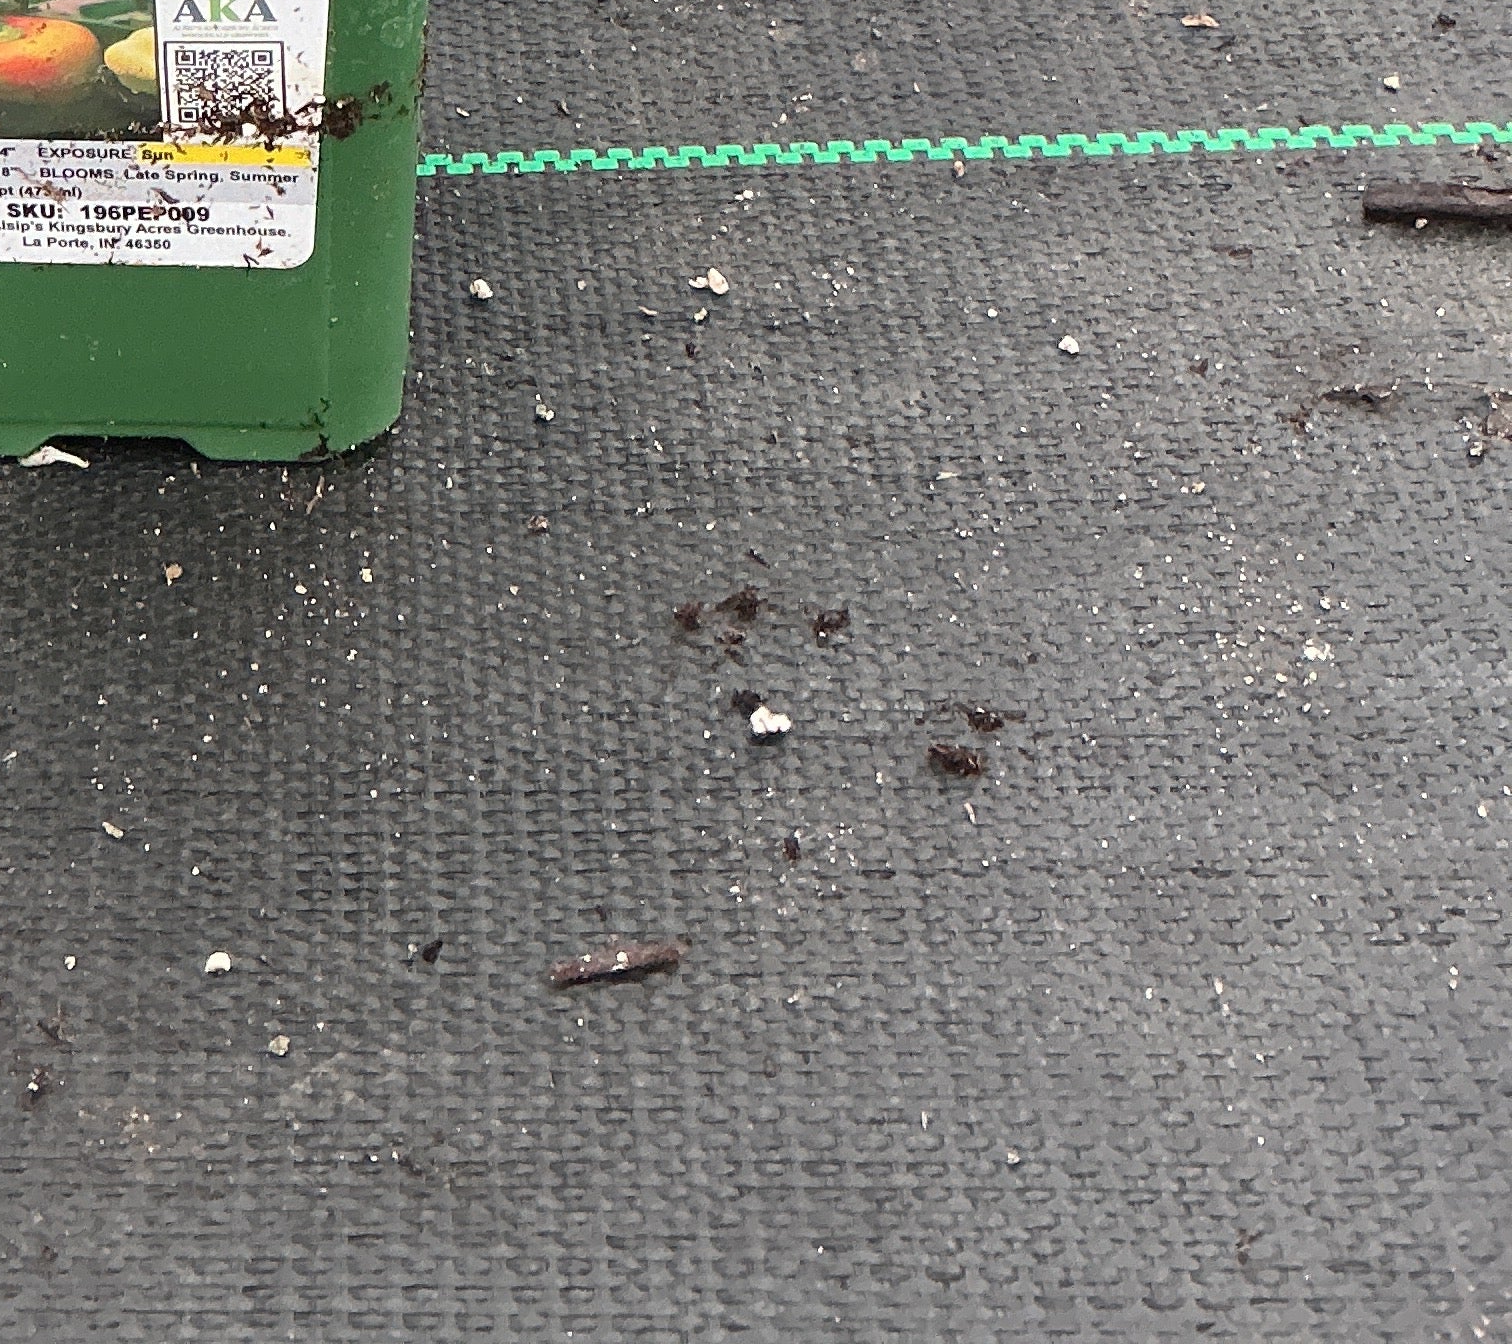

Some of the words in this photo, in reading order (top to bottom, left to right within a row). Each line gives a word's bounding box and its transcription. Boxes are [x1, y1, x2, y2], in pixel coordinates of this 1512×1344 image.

[141, 149, 174, 161] Sun
[124, 169, 160, 181] Late
[164, 170, 224, 184] Spring,
[229, 171, 299, 184] Summer
[7, 202, 64, 220] SKU:
[49, 220, 132, 235] Kingsbury
[135, 223, 182, 235] Acres
[22, 236, 42, 247] La
[125, 238, 172, 250] 46350
